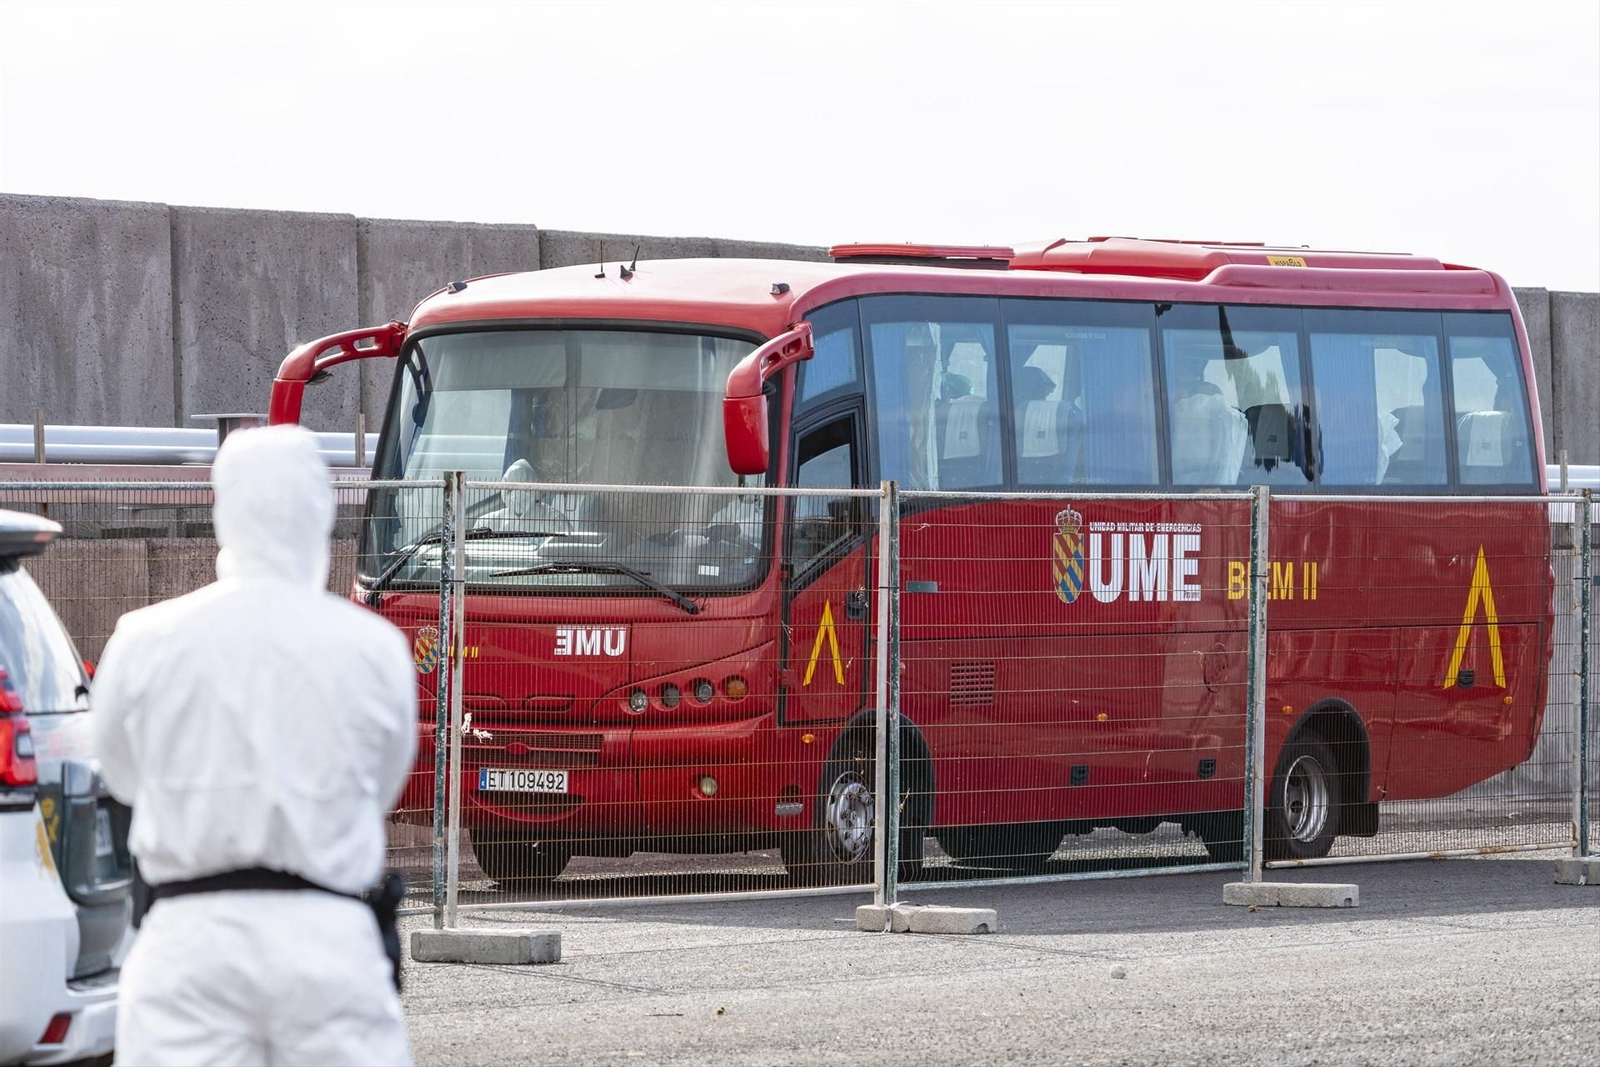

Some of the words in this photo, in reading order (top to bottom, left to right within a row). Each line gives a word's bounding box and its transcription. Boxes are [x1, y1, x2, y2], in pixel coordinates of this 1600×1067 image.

[1089, 521, 1115, 531] UNIDAD
[1117, 522, 1144, 532] MILITAR
[1145, 522, 1155, 532] DE
[1156, 523, 1201, 533] EMERGENCIAS
[1089, 533, 1201, 603] UME
[1303, 561, 1317, 600] II
